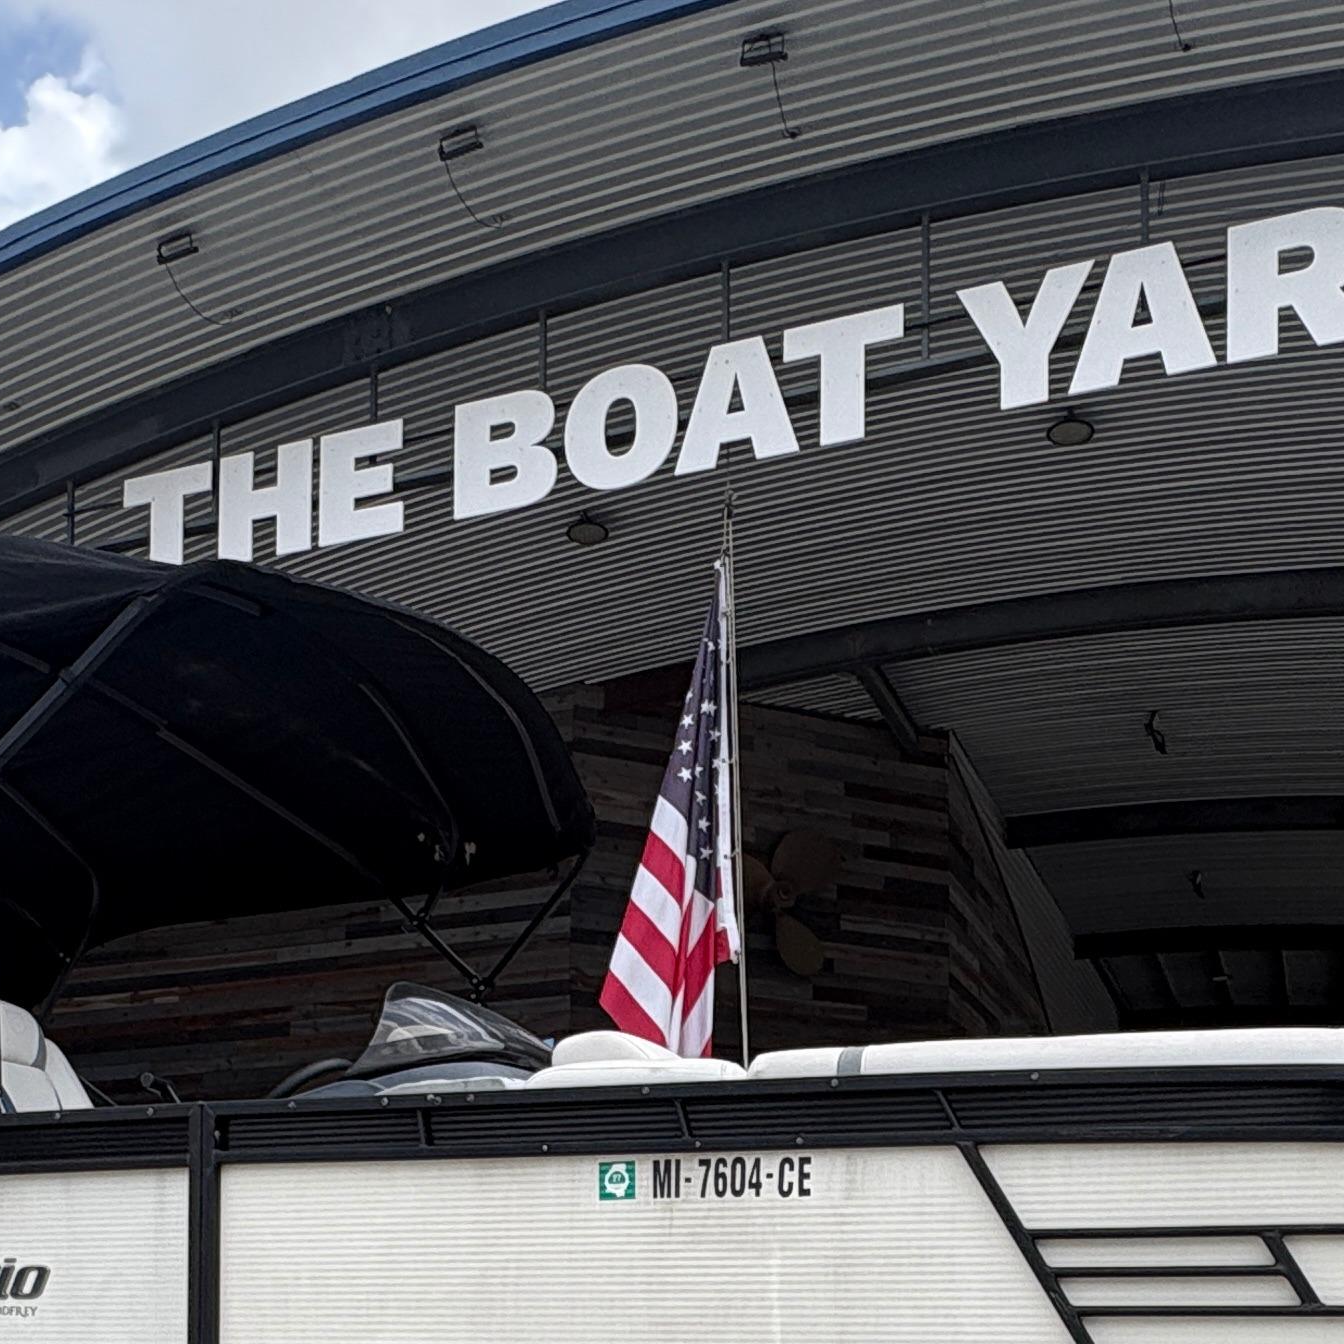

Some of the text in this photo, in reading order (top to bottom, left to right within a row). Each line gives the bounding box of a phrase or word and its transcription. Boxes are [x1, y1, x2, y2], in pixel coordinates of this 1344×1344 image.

[123, 419, 404, 565] THE
[454, 303, 905, 521] BOAT
[652, 1156, 812, 1199] MI-7604-CE
